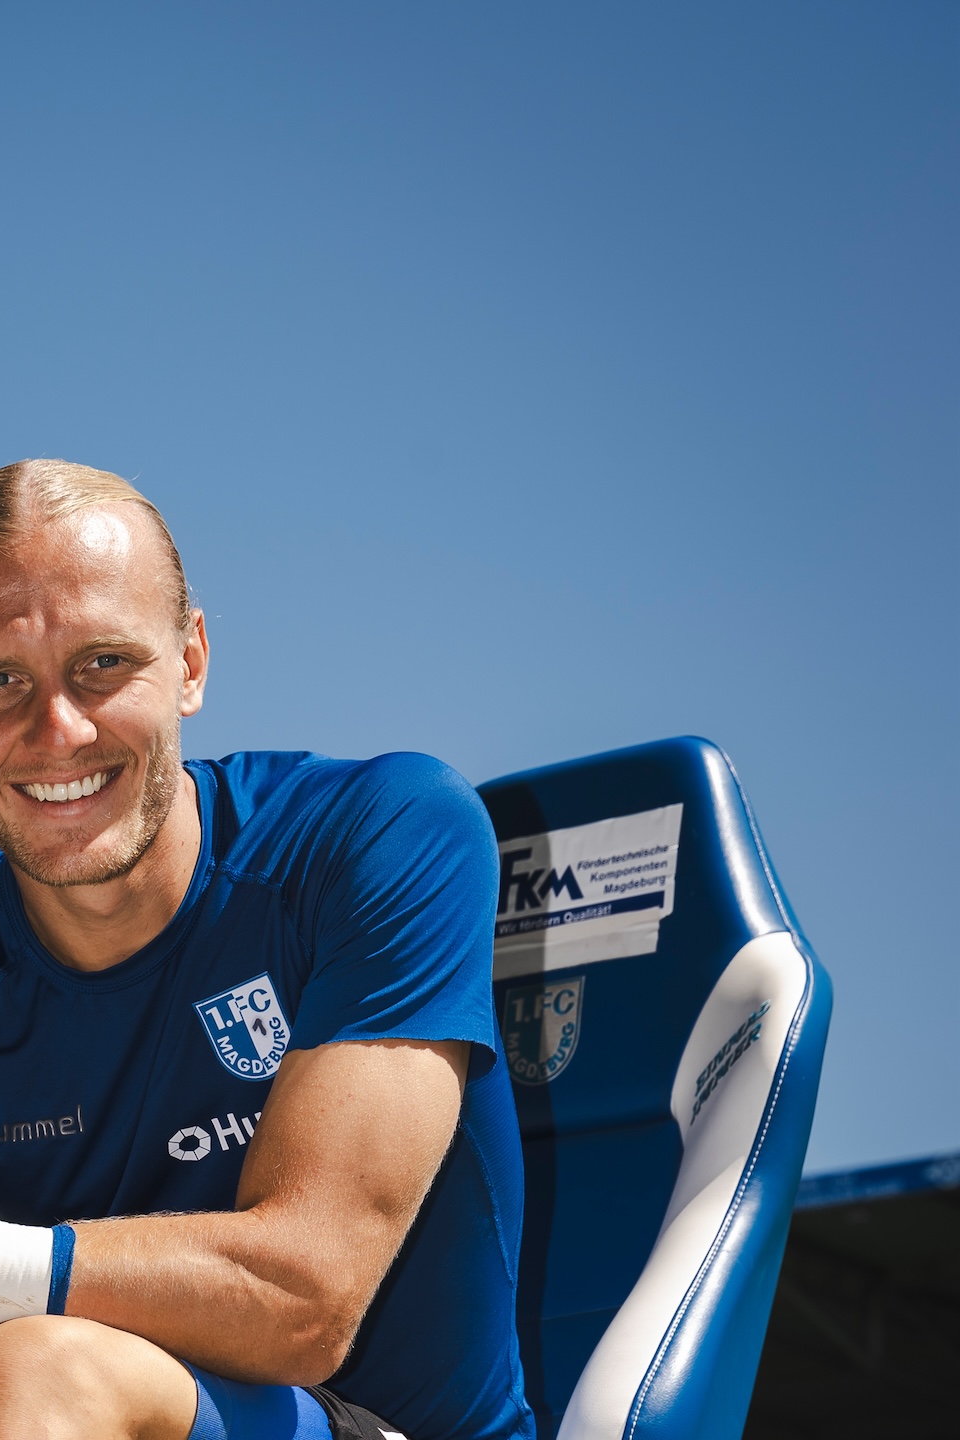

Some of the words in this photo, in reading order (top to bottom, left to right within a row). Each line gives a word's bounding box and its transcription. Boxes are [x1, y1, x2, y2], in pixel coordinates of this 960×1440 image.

[577, 844, 669, 871] Fördertechnische
[589, 860, 668, 884] Komponenten
[497, 847, 584, 915] FKM
[602, 873, 667, 895] Magdeburg
[562, 904, 612, 925] Qualität!
[217, 1016, 286, 1074] MAGDEBURG
[506, 1021, 575, 1078] MAGDEBURG
[211, 1111, 262, 1151] Hu
